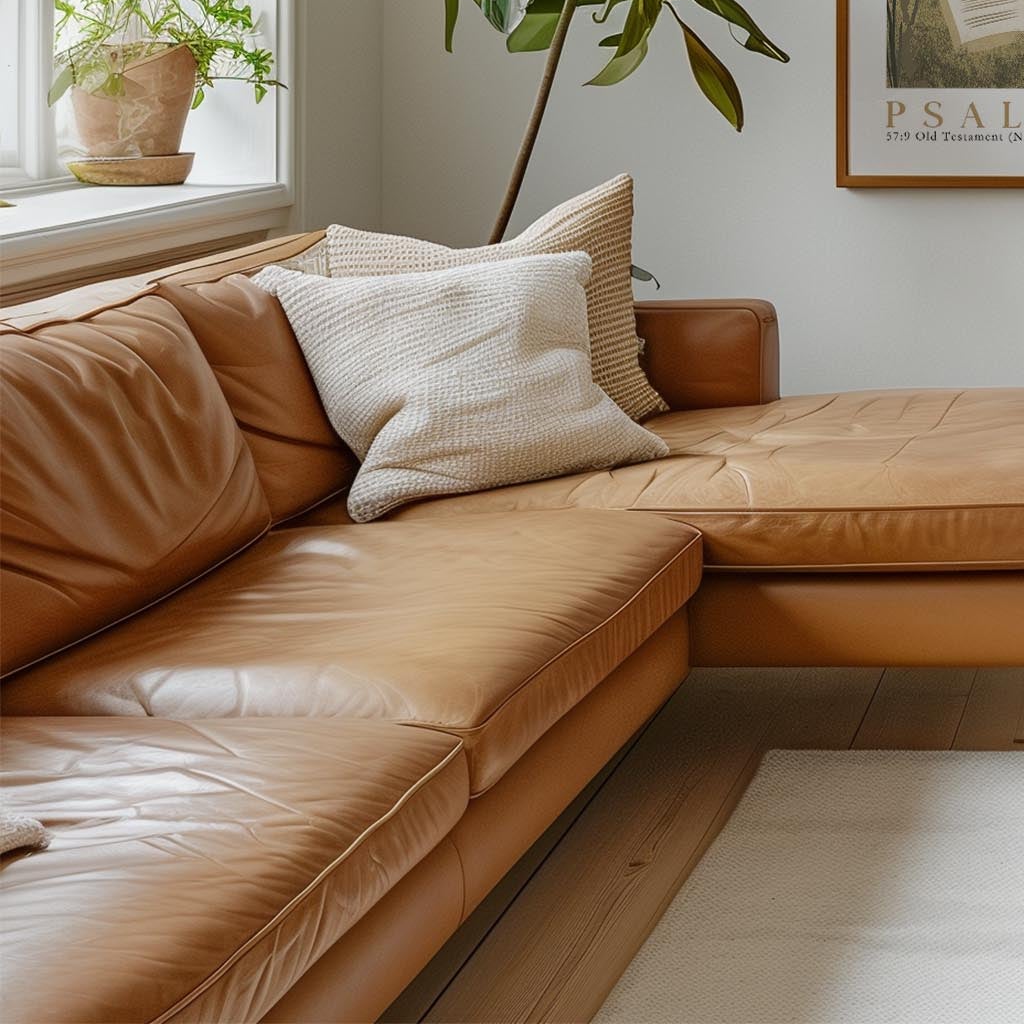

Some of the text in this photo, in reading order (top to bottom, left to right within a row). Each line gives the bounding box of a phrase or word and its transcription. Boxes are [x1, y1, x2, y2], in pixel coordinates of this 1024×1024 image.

[886, 131, 911, 142] 57:9
[915, 131, 937, 142] Old
[942, 131, 1004, 142] Testament
